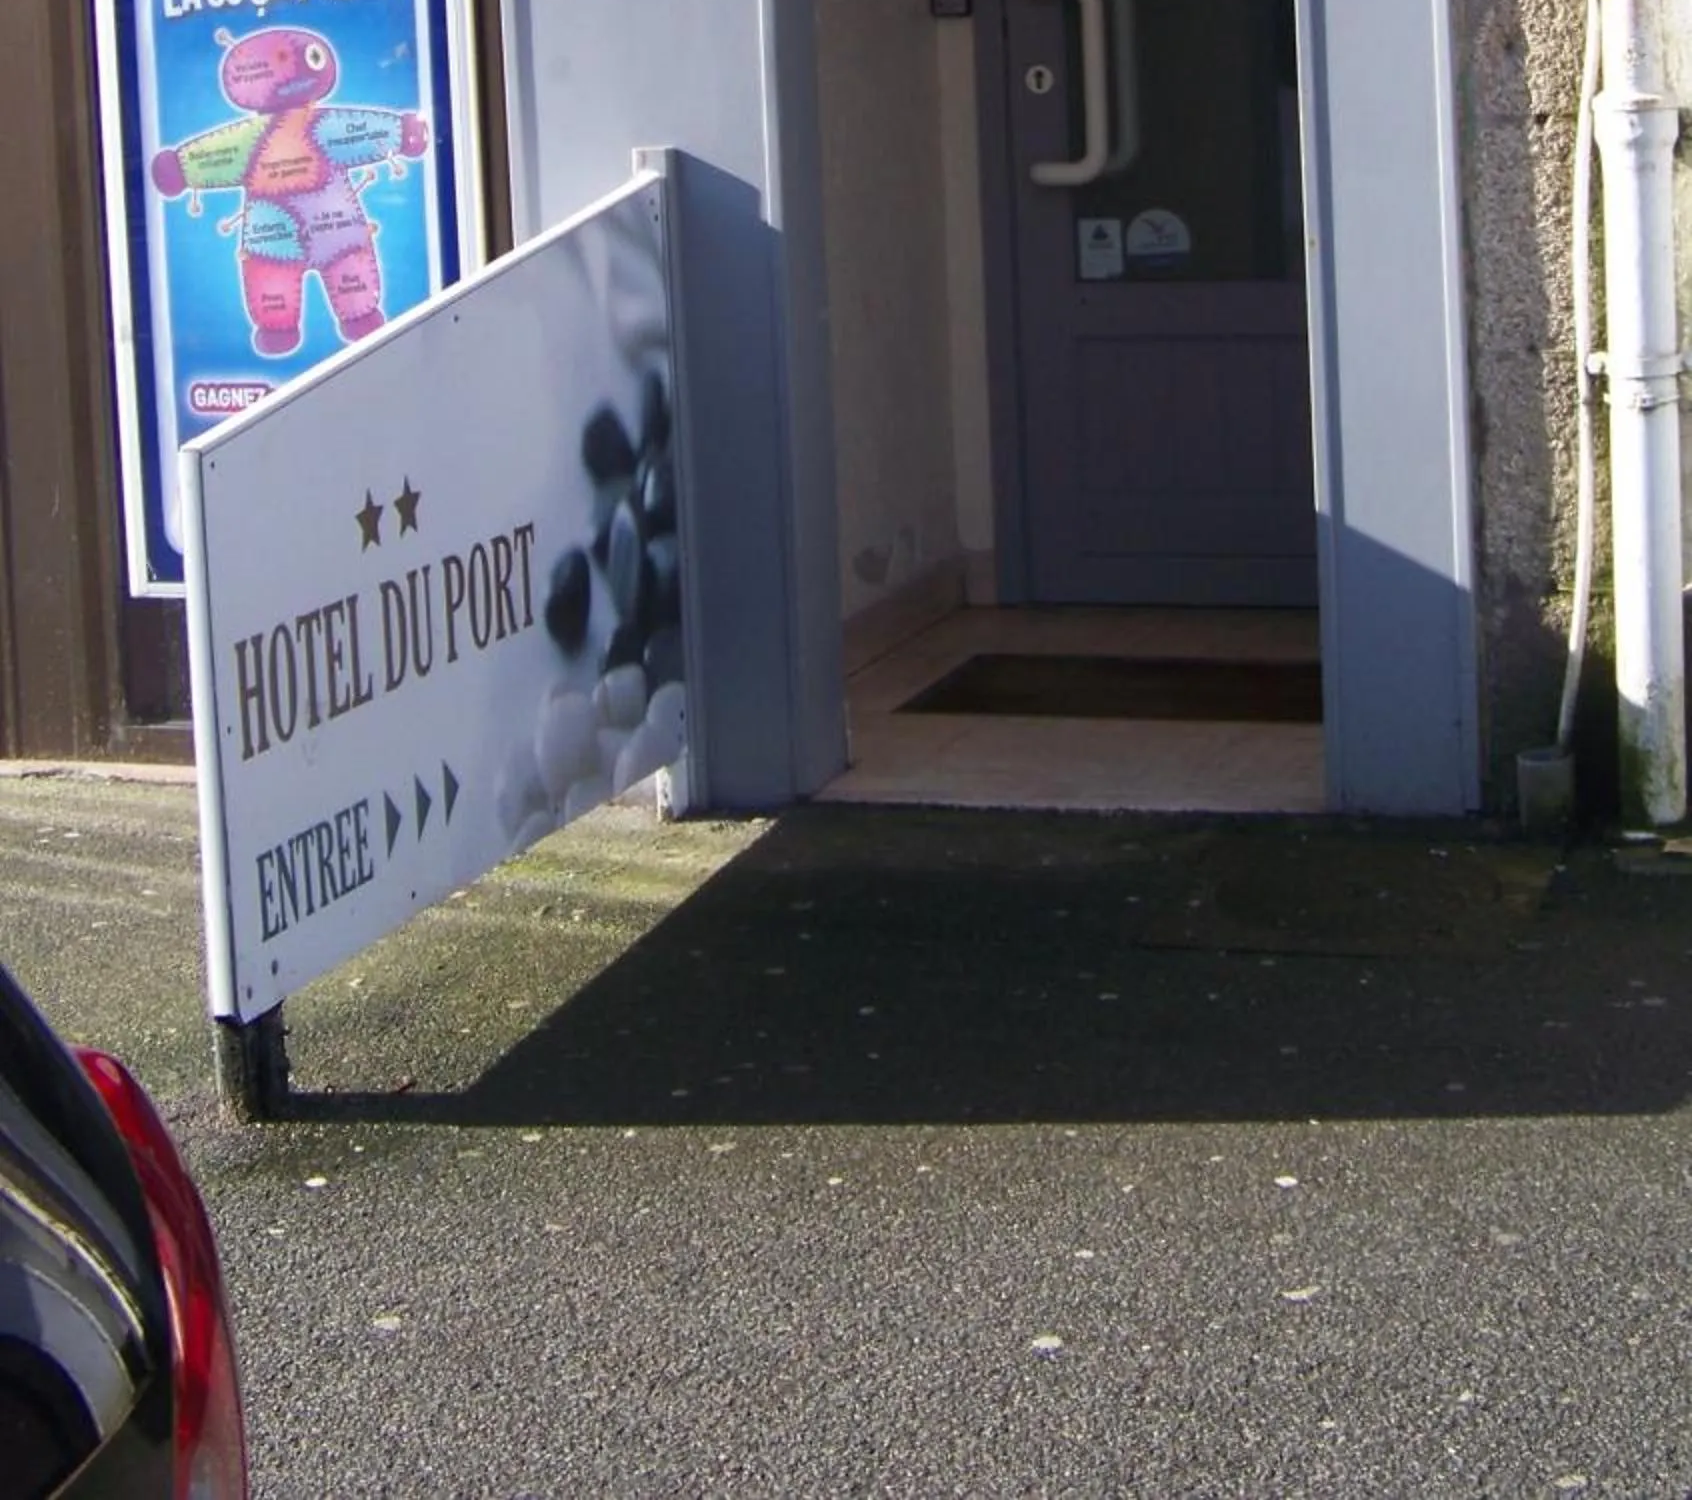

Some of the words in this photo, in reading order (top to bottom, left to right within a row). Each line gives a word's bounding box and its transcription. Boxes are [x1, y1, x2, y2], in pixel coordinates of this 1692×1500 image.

[234, 593, 373, 762] HOTEL
[379, 564, 432, 692] DU
[442, 521, 535, 663] PORT
[256, 798, 374, 943] ENTREE
